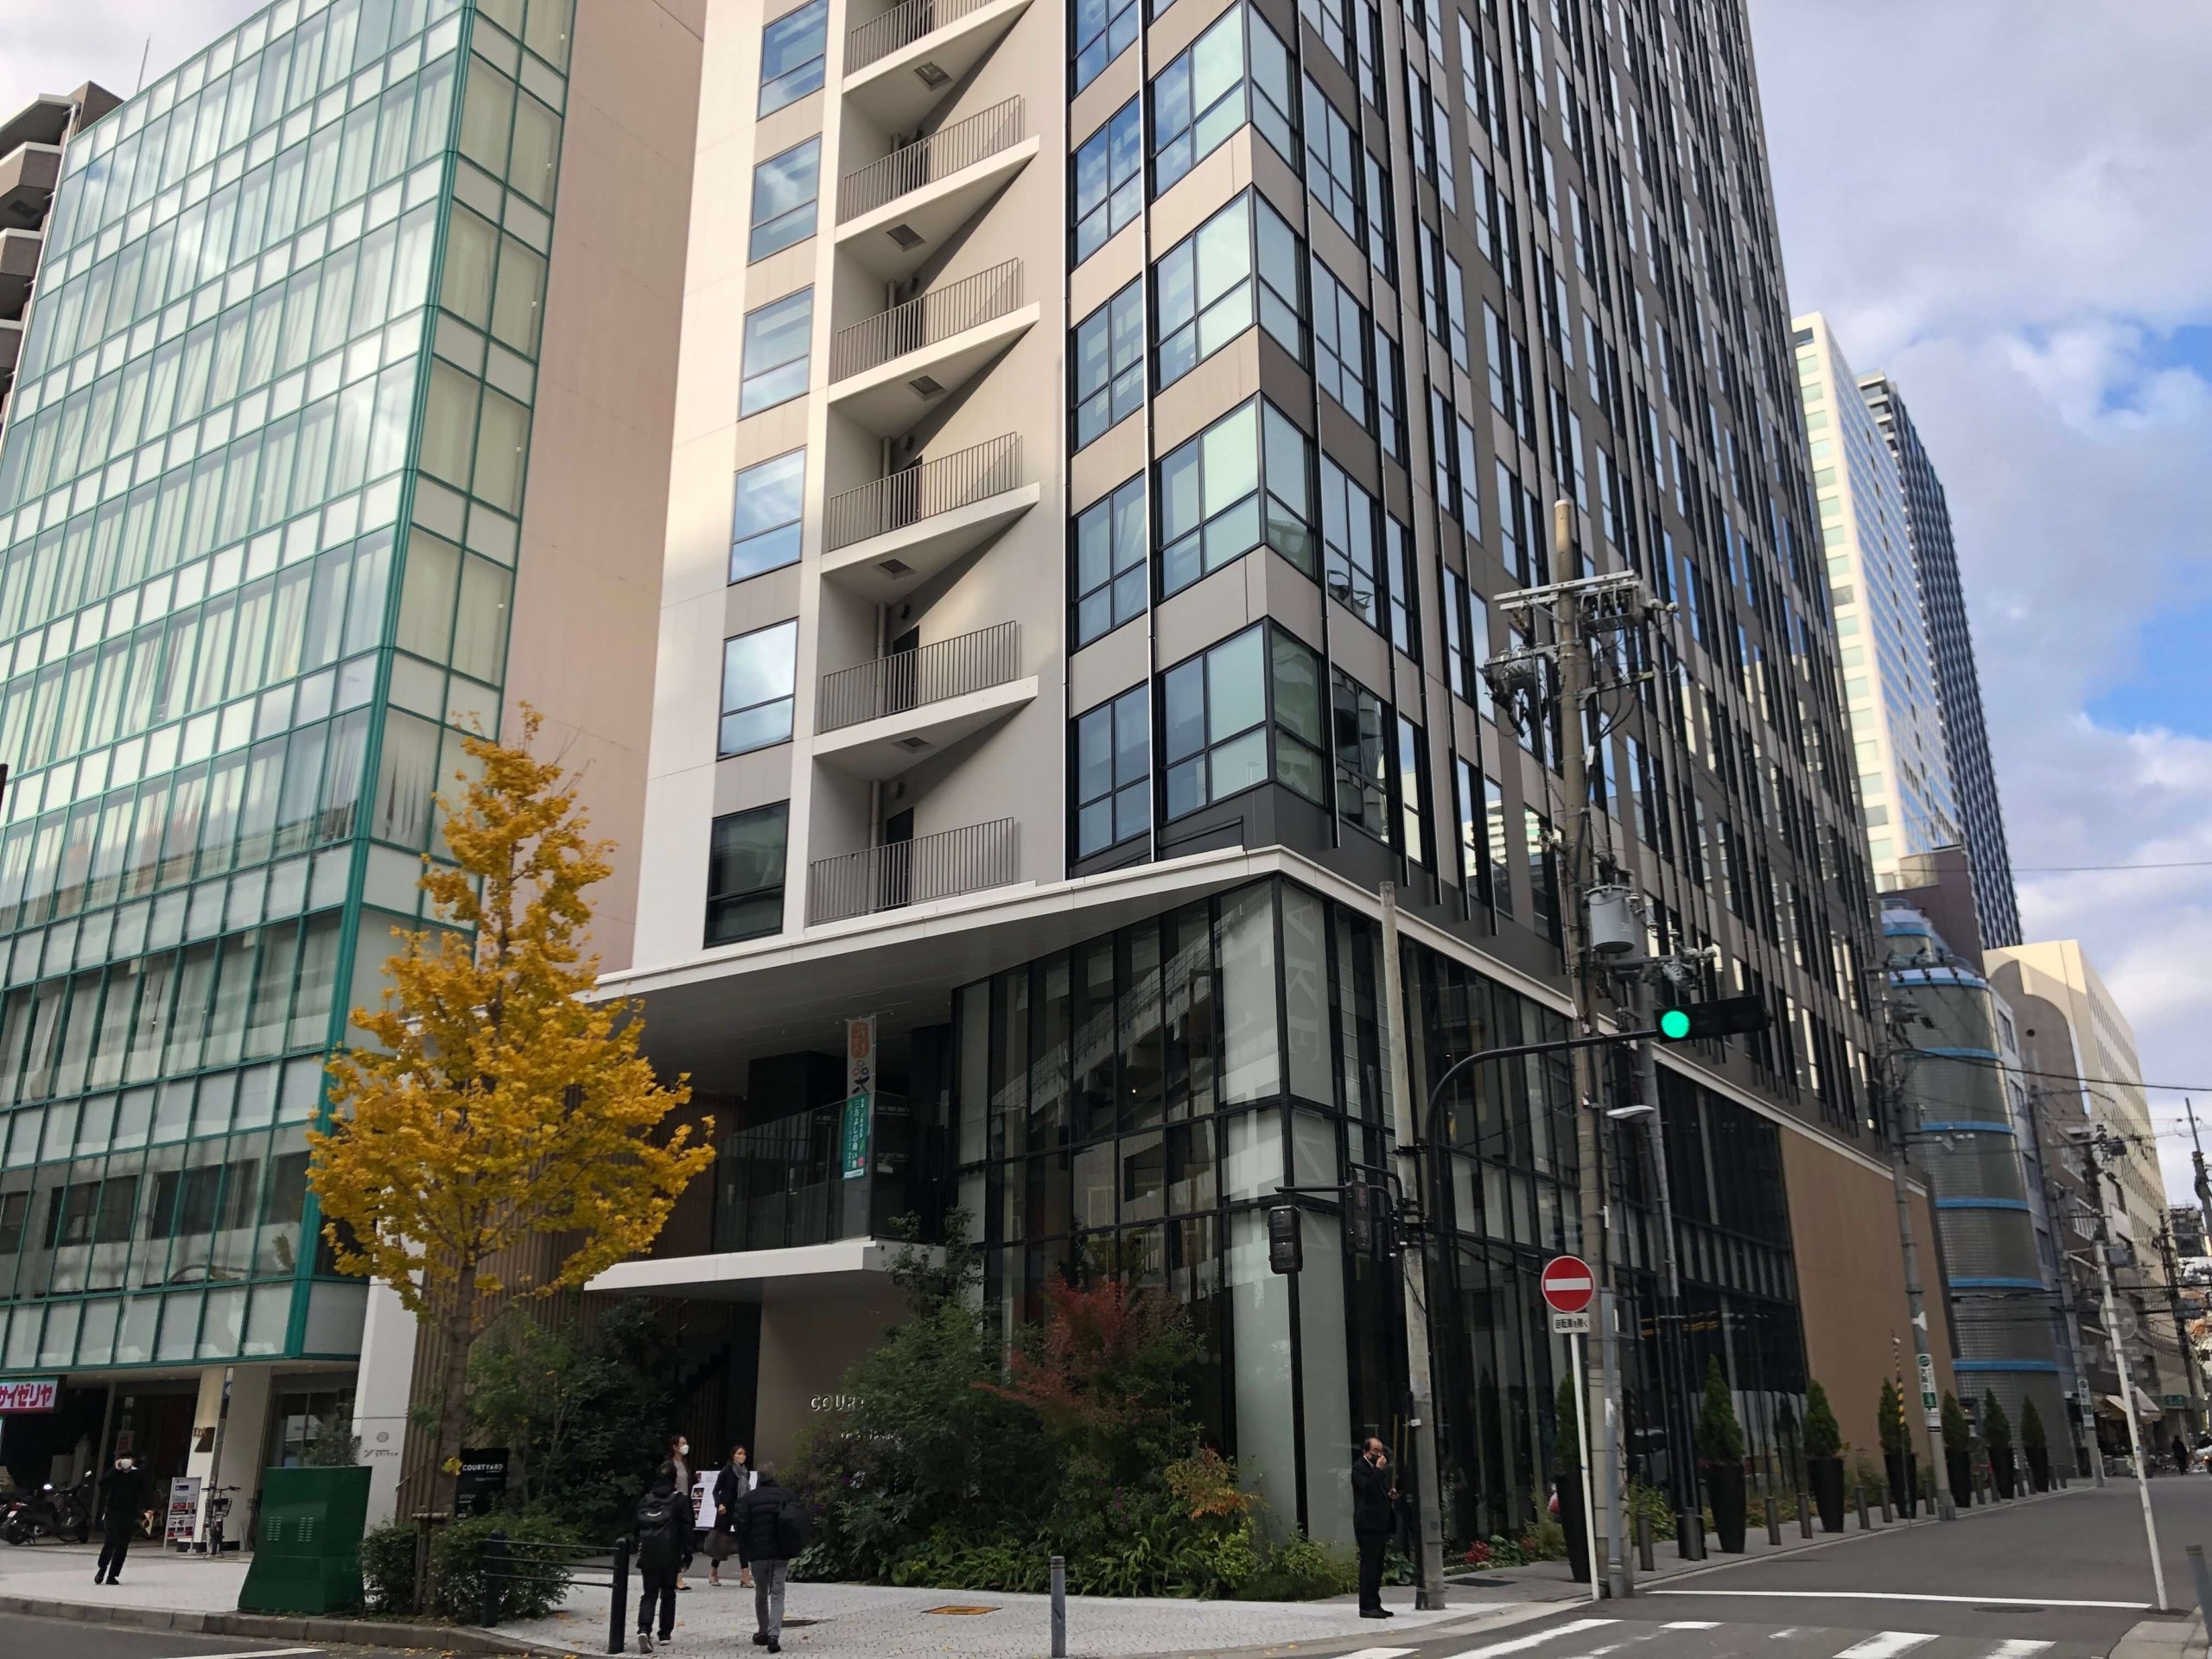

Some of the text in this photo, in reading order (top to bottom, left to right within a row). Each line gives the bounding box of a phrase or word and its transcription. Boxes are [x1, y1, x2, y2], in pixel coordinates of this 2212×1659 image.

[0, 1383, 53, 1407] サイゼリヤ
